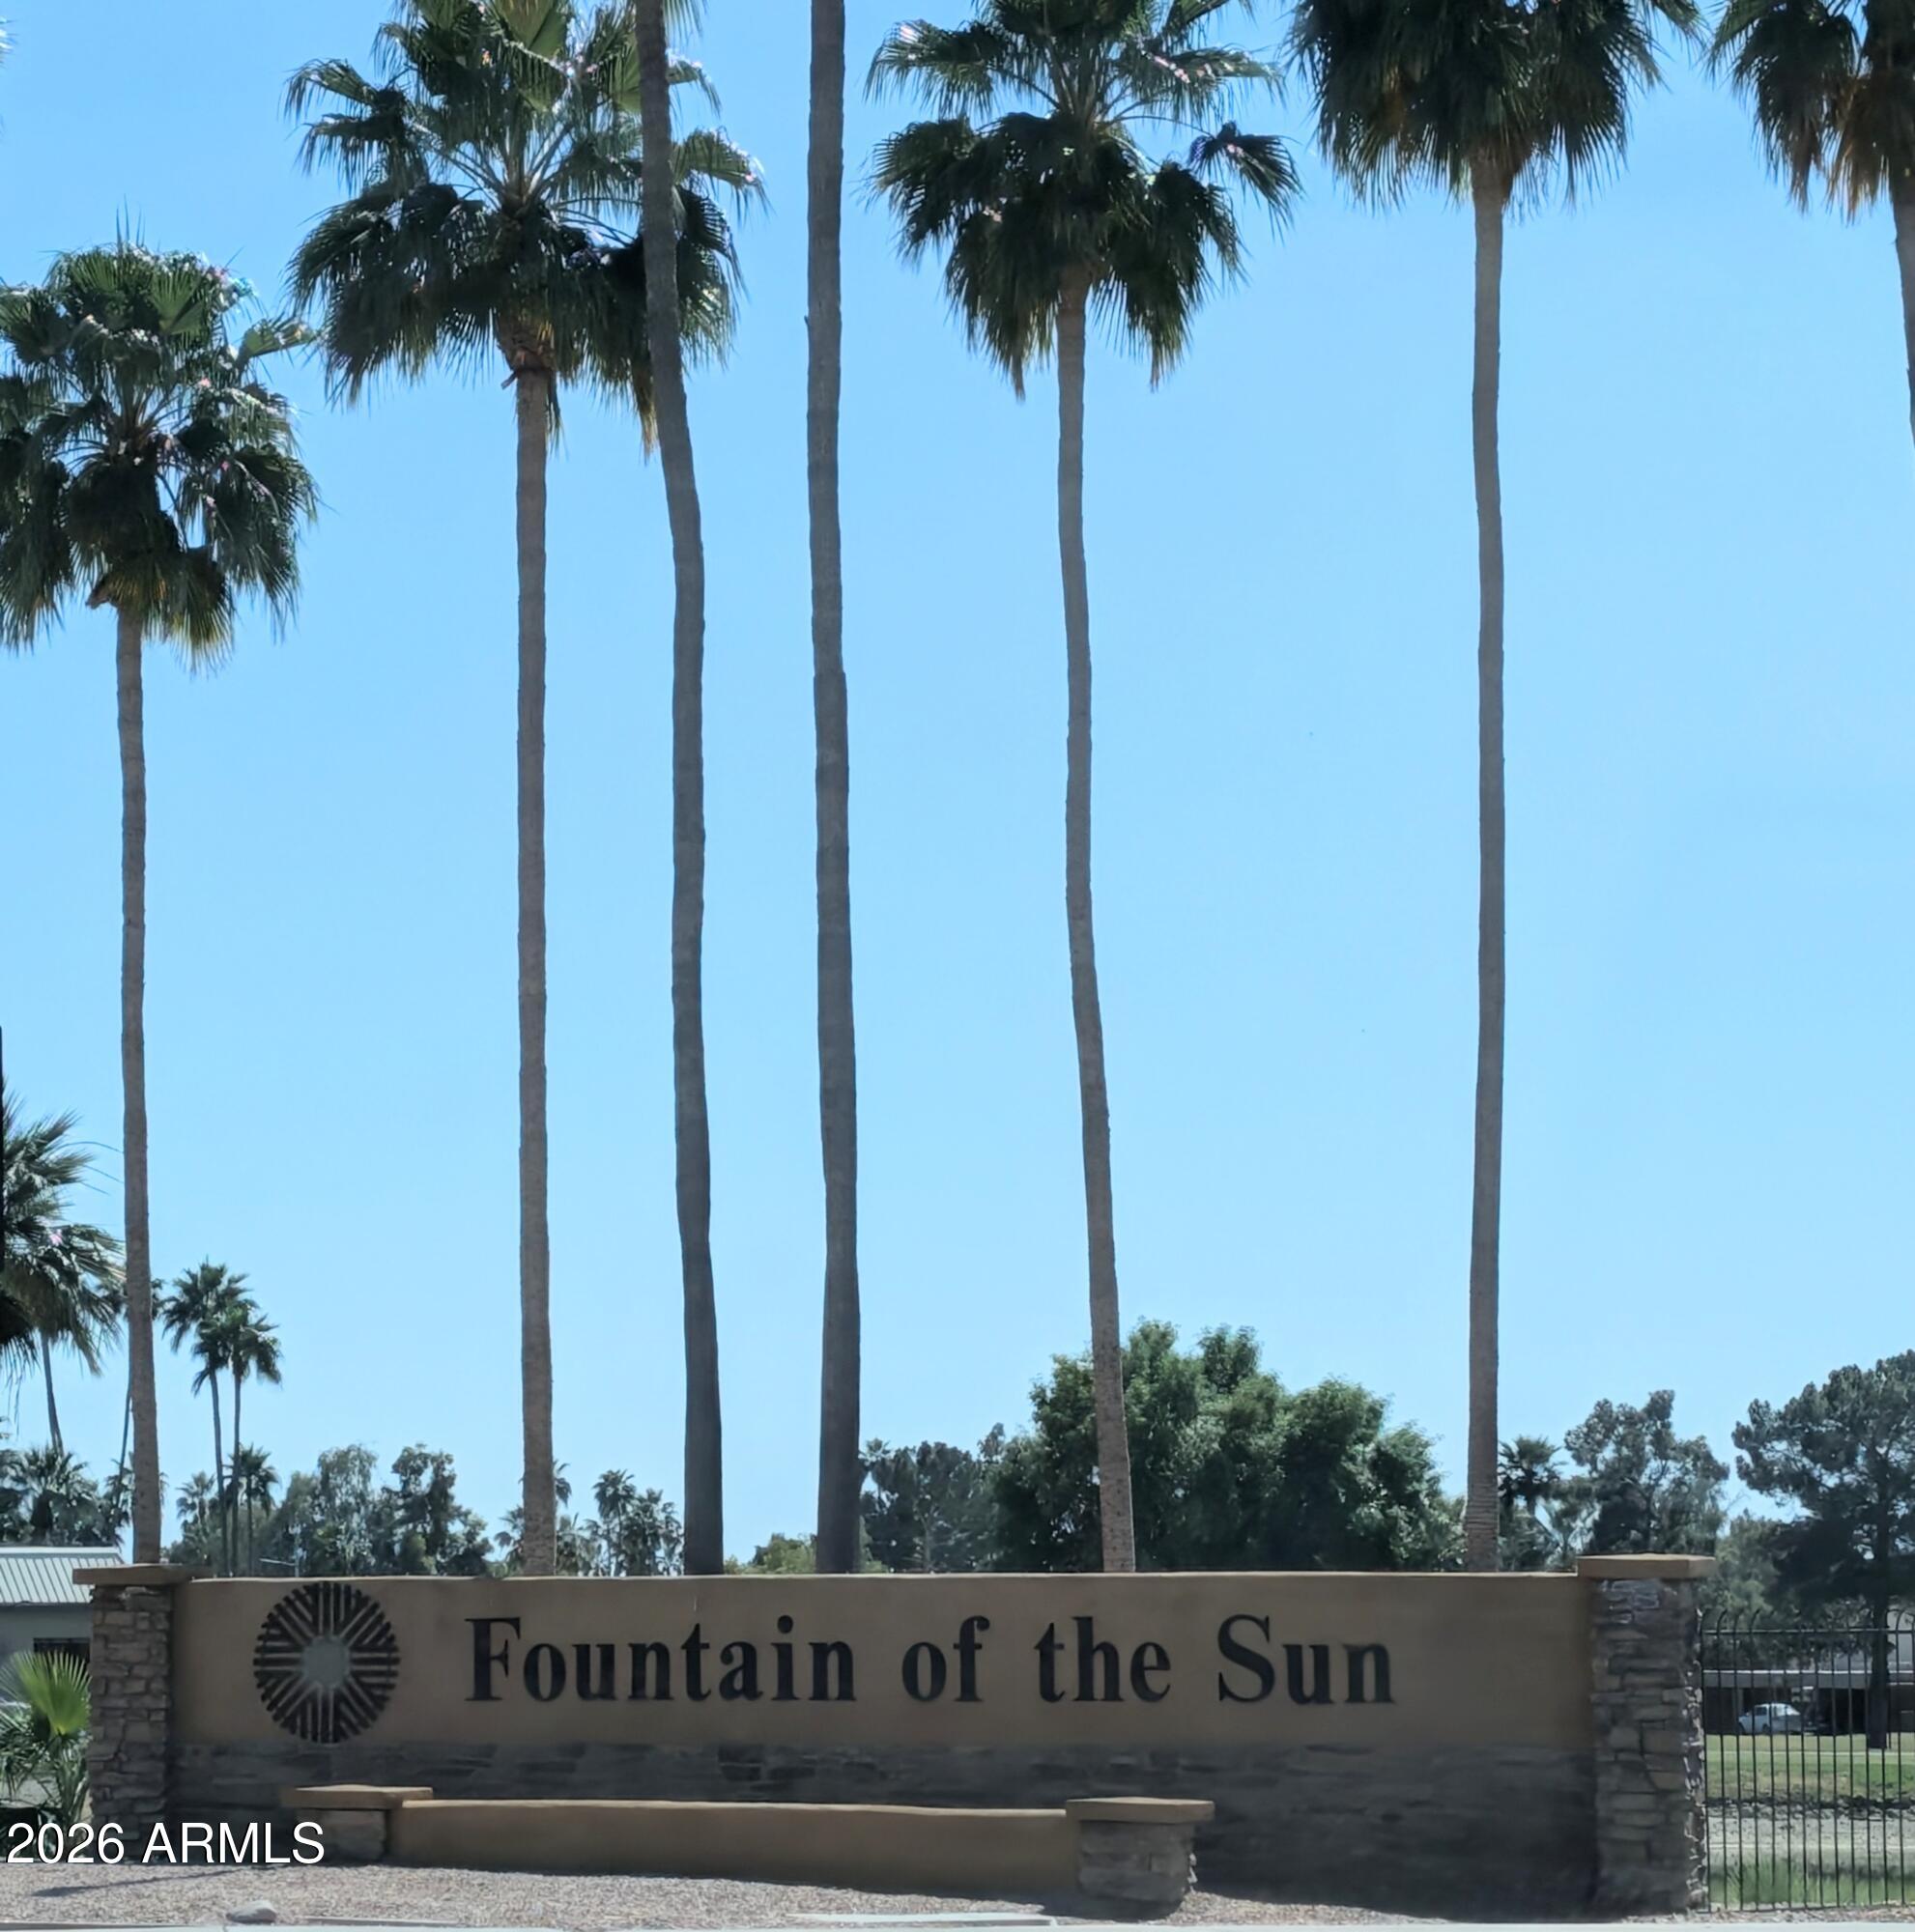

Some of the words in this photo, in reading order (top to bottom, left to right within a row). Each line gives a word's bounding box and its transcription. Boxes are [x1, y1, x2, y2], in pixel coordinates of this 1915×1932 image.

[464, 1613, 857, 1704] Fountain
[900, 1614, 991, 1703] of
[1033, 1614, 1171, 1703] the
[1216, 1613, 1396, 1706] Sun
